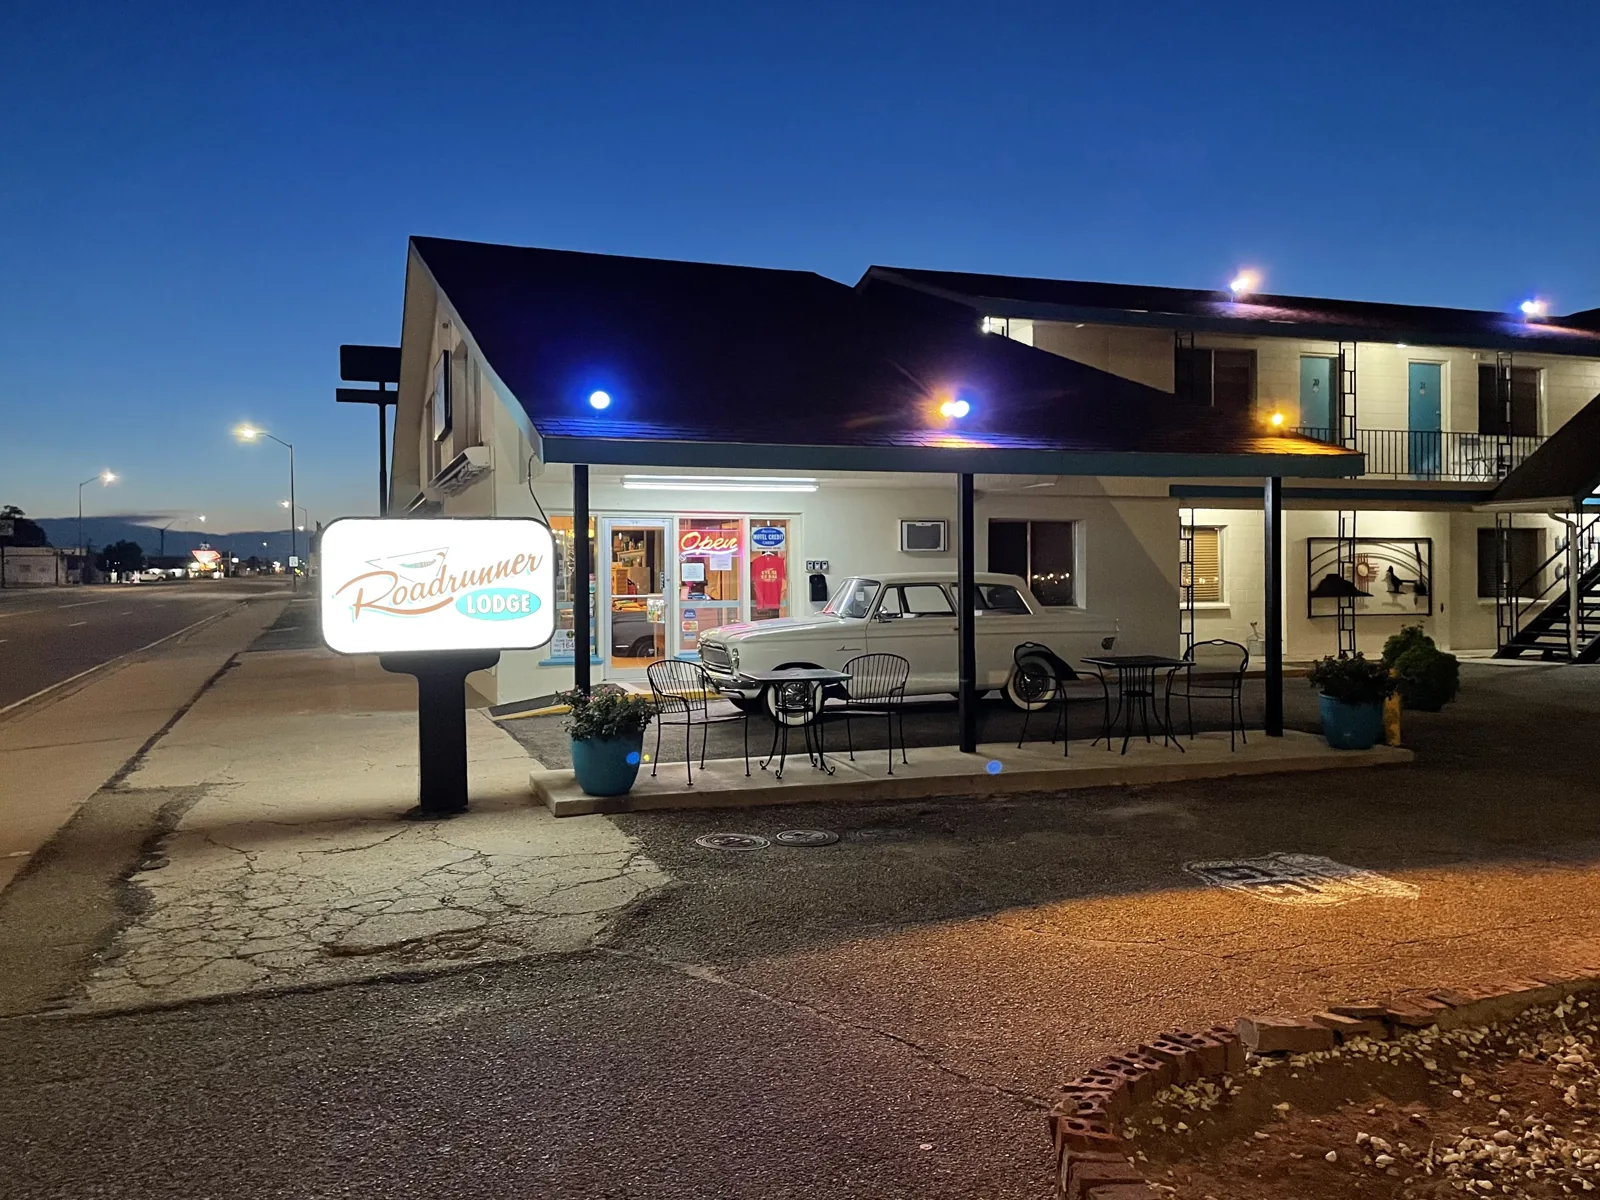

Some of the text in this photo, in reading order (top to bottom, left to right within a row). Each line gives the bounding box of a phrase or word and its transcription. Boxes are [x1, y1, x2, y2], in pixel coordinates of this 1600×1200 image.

[681, 531, 738, 555] Open
[768, 533, 784, 541] CREDIT
[335, 552, 543, 620] Roadrunner
[466, 594, 531, 614] LODGE
